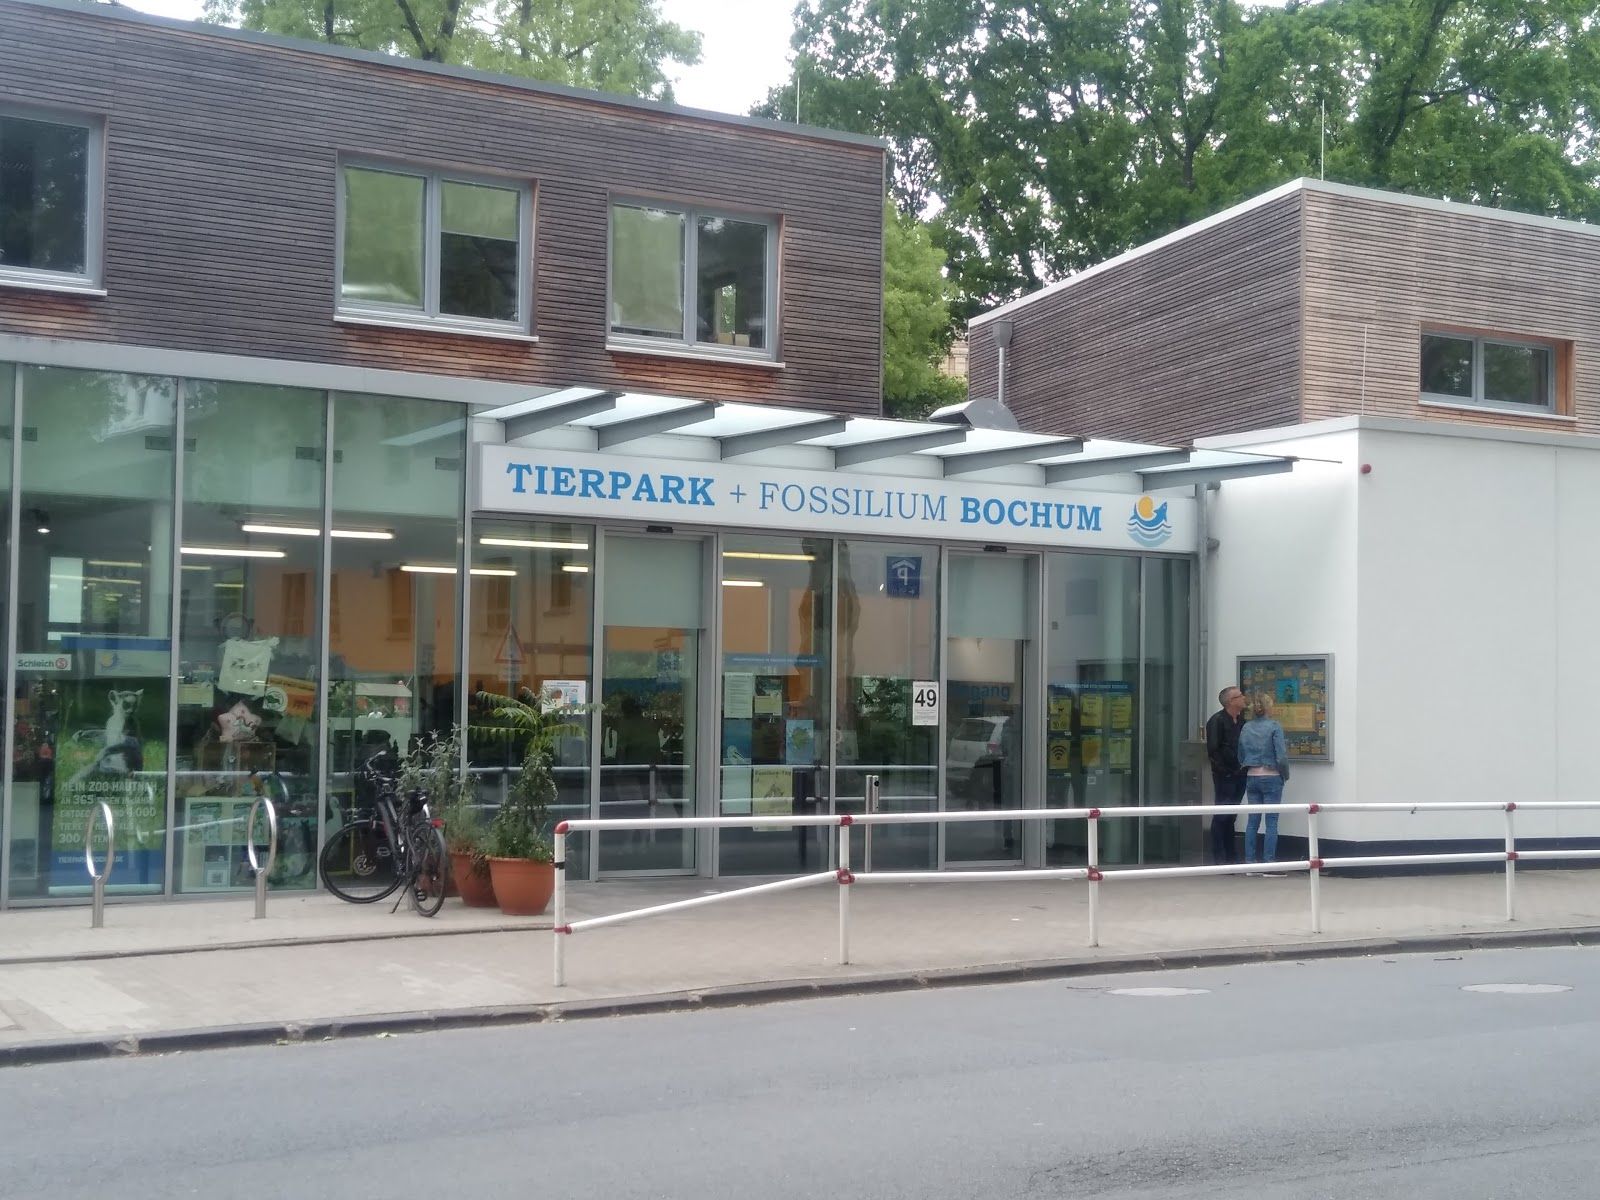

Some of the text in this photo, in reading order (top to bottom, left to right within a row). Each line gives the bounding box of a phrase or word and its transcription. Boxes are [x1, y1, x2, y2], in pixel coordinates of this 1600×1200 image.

[506, 462, 1102, 532] TIERPARK + FOSSILIUM BOCHUM
[17, 659, 55, 668] Schleich
[914, 688, 937, 708] 49
[61, 781, 158, 793] MEIN ZOO HAUTNAH
[73, 794, 94, 804] 365
[58, 833, 81, 844] 300
